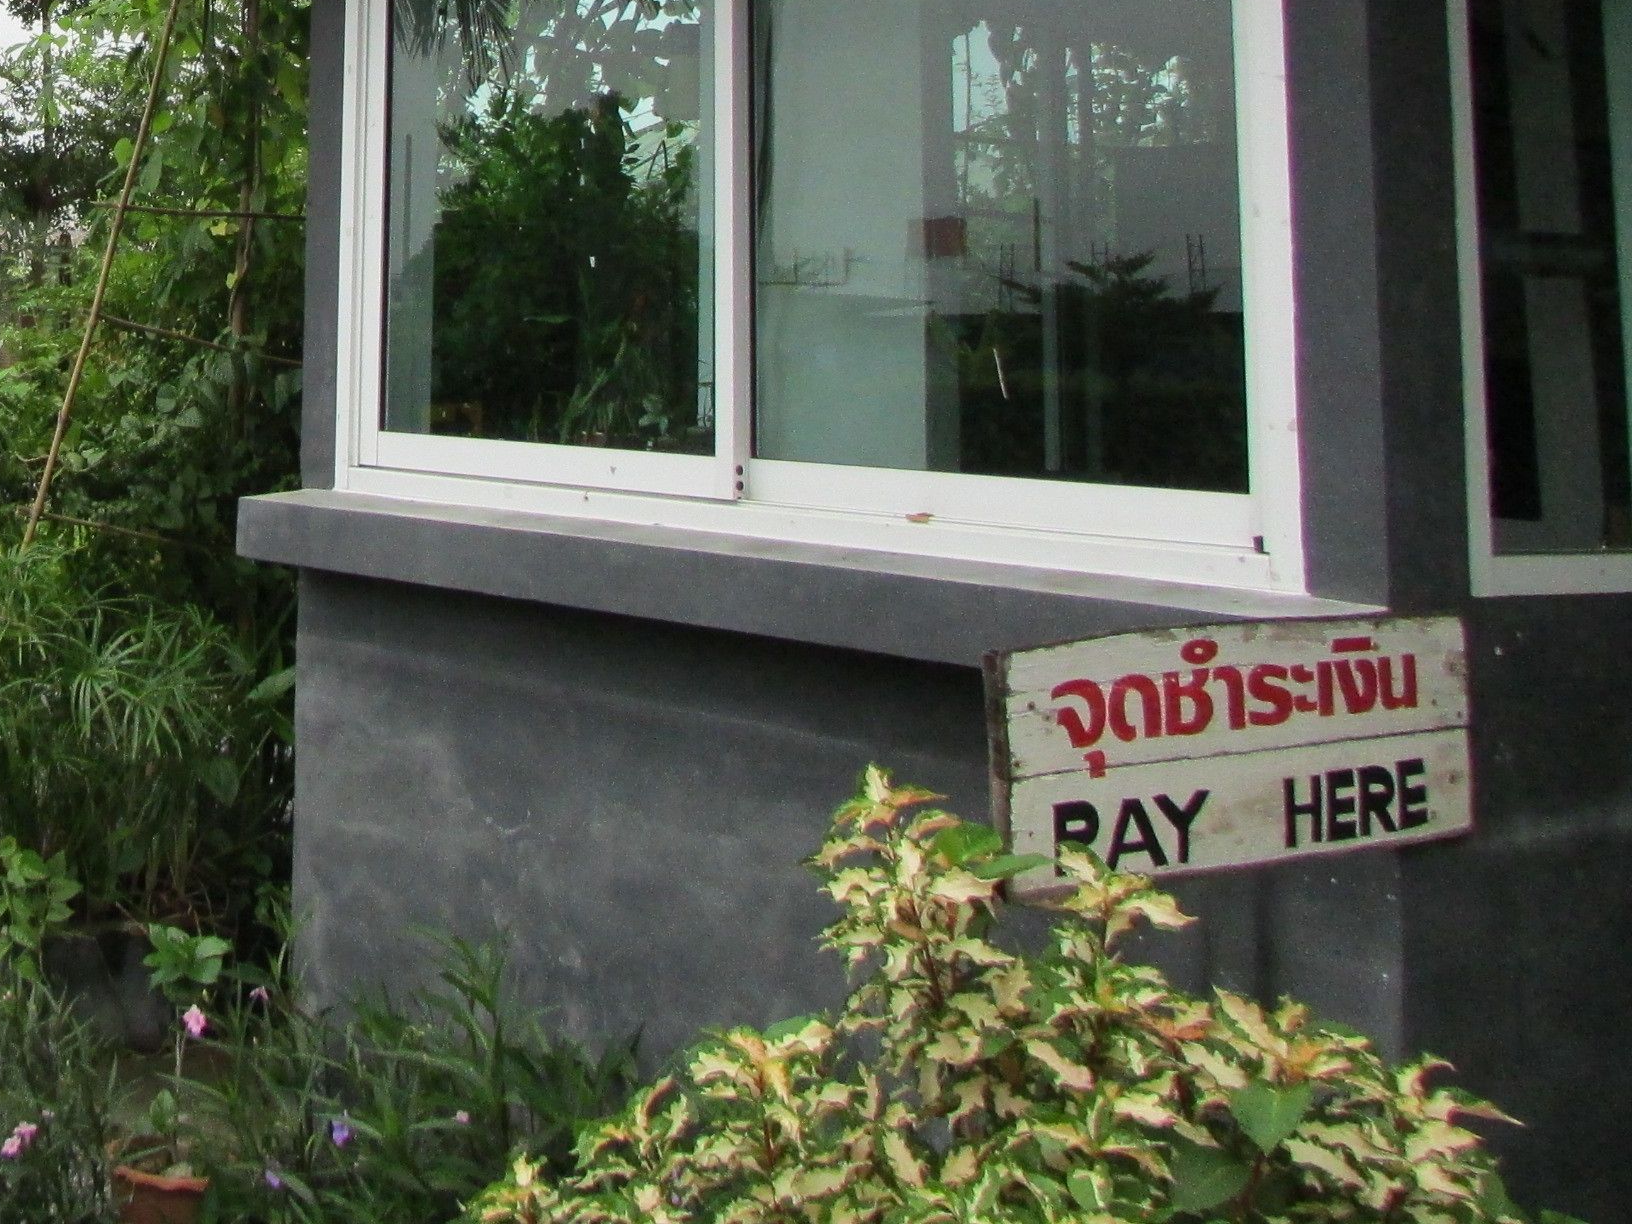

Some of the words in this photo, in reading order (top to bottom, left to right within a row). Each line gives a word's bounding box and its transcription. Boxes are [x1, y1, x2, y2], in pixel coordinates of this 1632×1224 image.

[1051, 636, 1418, 778] จุดชำระเงิน
[1052, 789, 1209, 877] PAY
[1283, 758, 1430, 848] HERE
